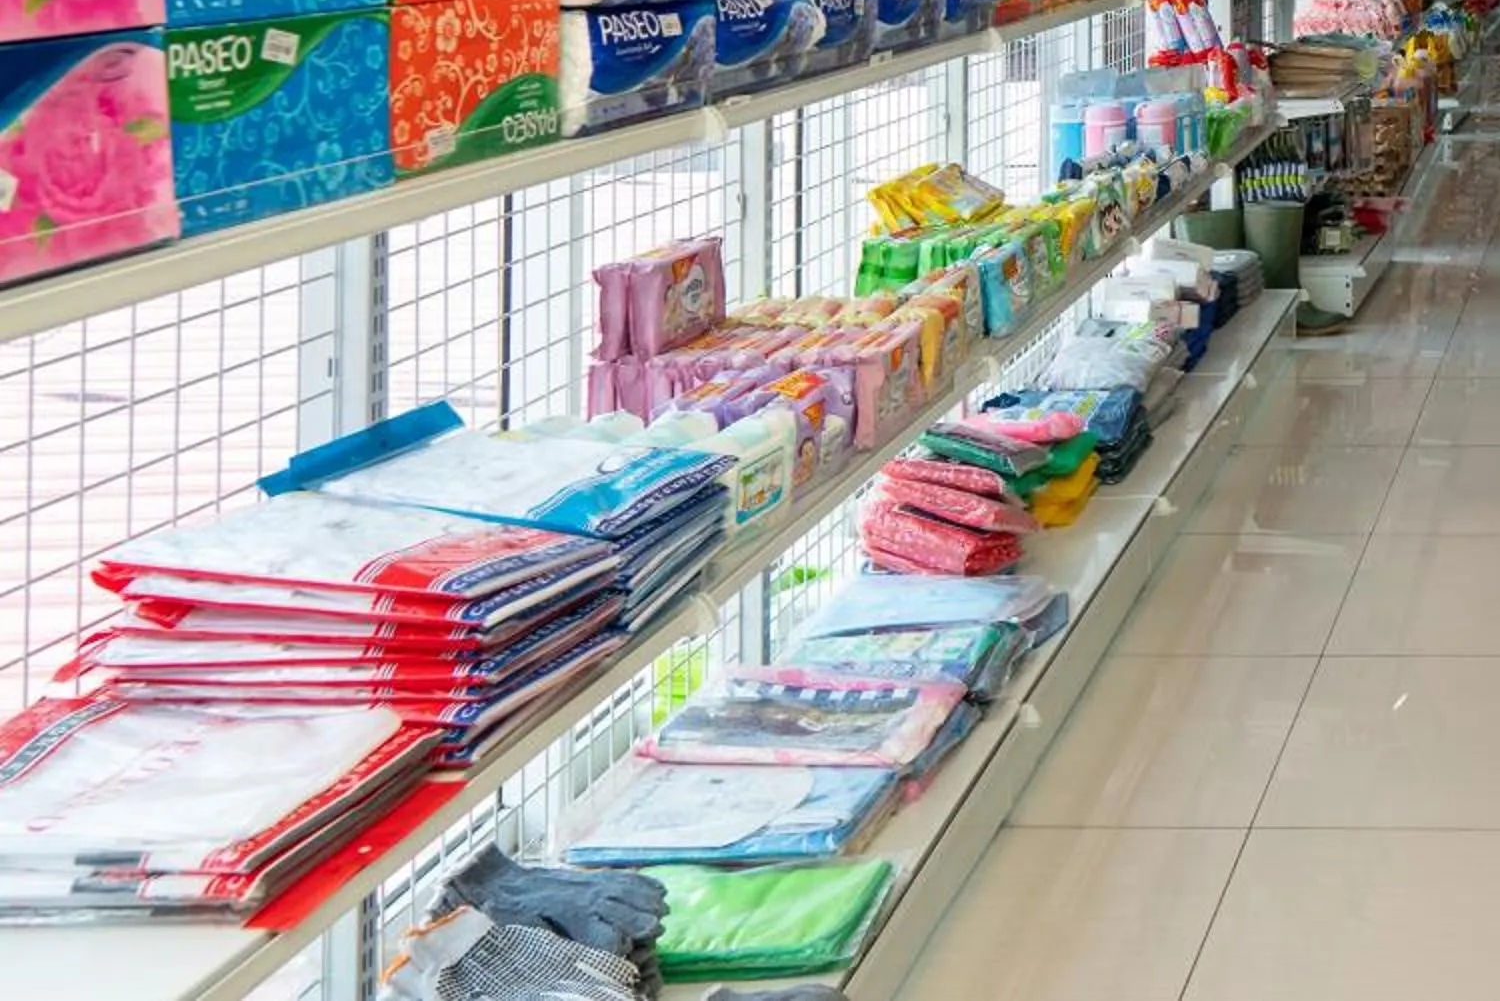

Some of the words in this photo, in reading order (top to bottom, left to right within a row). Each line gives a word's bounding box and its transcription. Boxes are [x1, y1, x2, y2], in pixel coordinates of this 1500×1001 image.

[597, 10, 661, 46] PASEO
[168, 35, 253, 80] PASEO
[502, 106, 558, 145] PASEO
